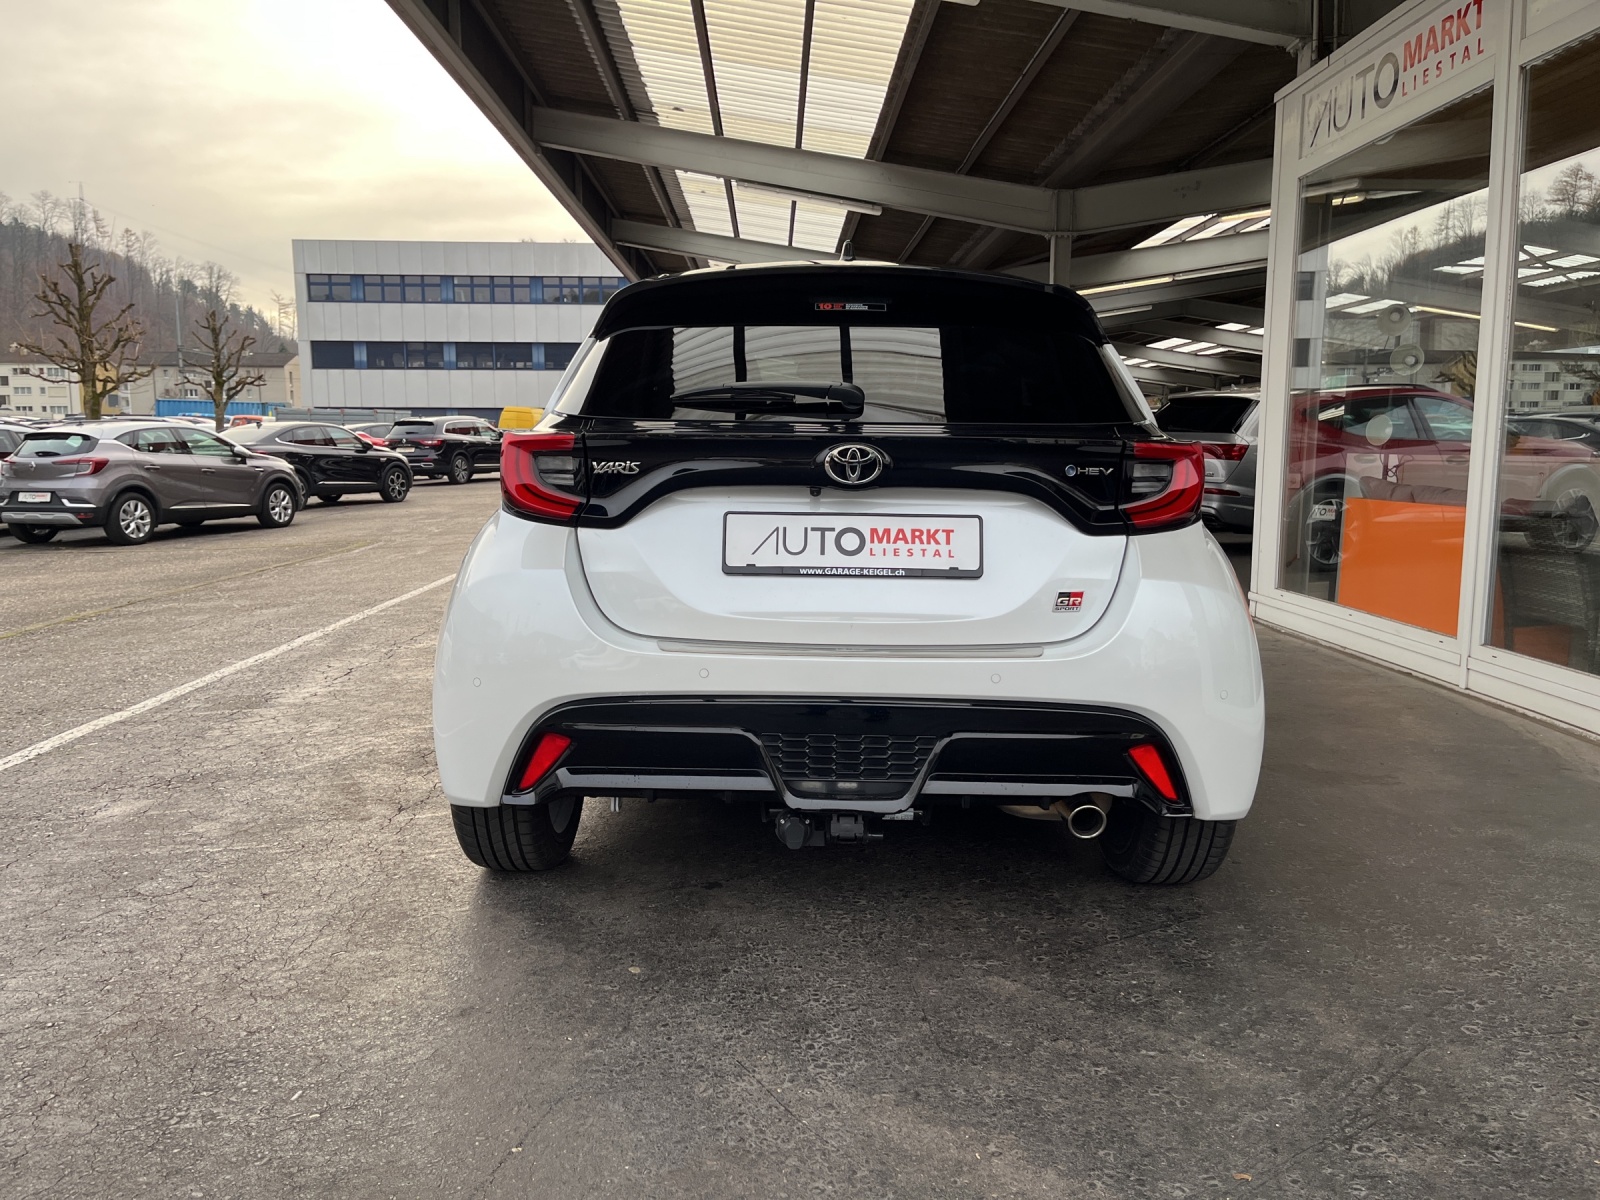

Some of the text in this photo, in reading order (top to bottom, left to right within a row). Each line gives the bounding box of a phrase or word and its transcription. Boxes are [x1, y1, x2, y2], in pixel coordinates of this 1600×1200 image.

[1401, 37, 1485, 98] LIESTAL
[1309, 0, 1485, 148] AUTO MARKT
[1077, 467, 1114, 476] HEV
[751, 526, 955, 557] AUTO MARKT
[869, 547, 955, 559] LIESTAL
[799, 567, 906, 576] www.GARAGE-KEIGEL.ch
[1056, 597, 1082, 606] GR
